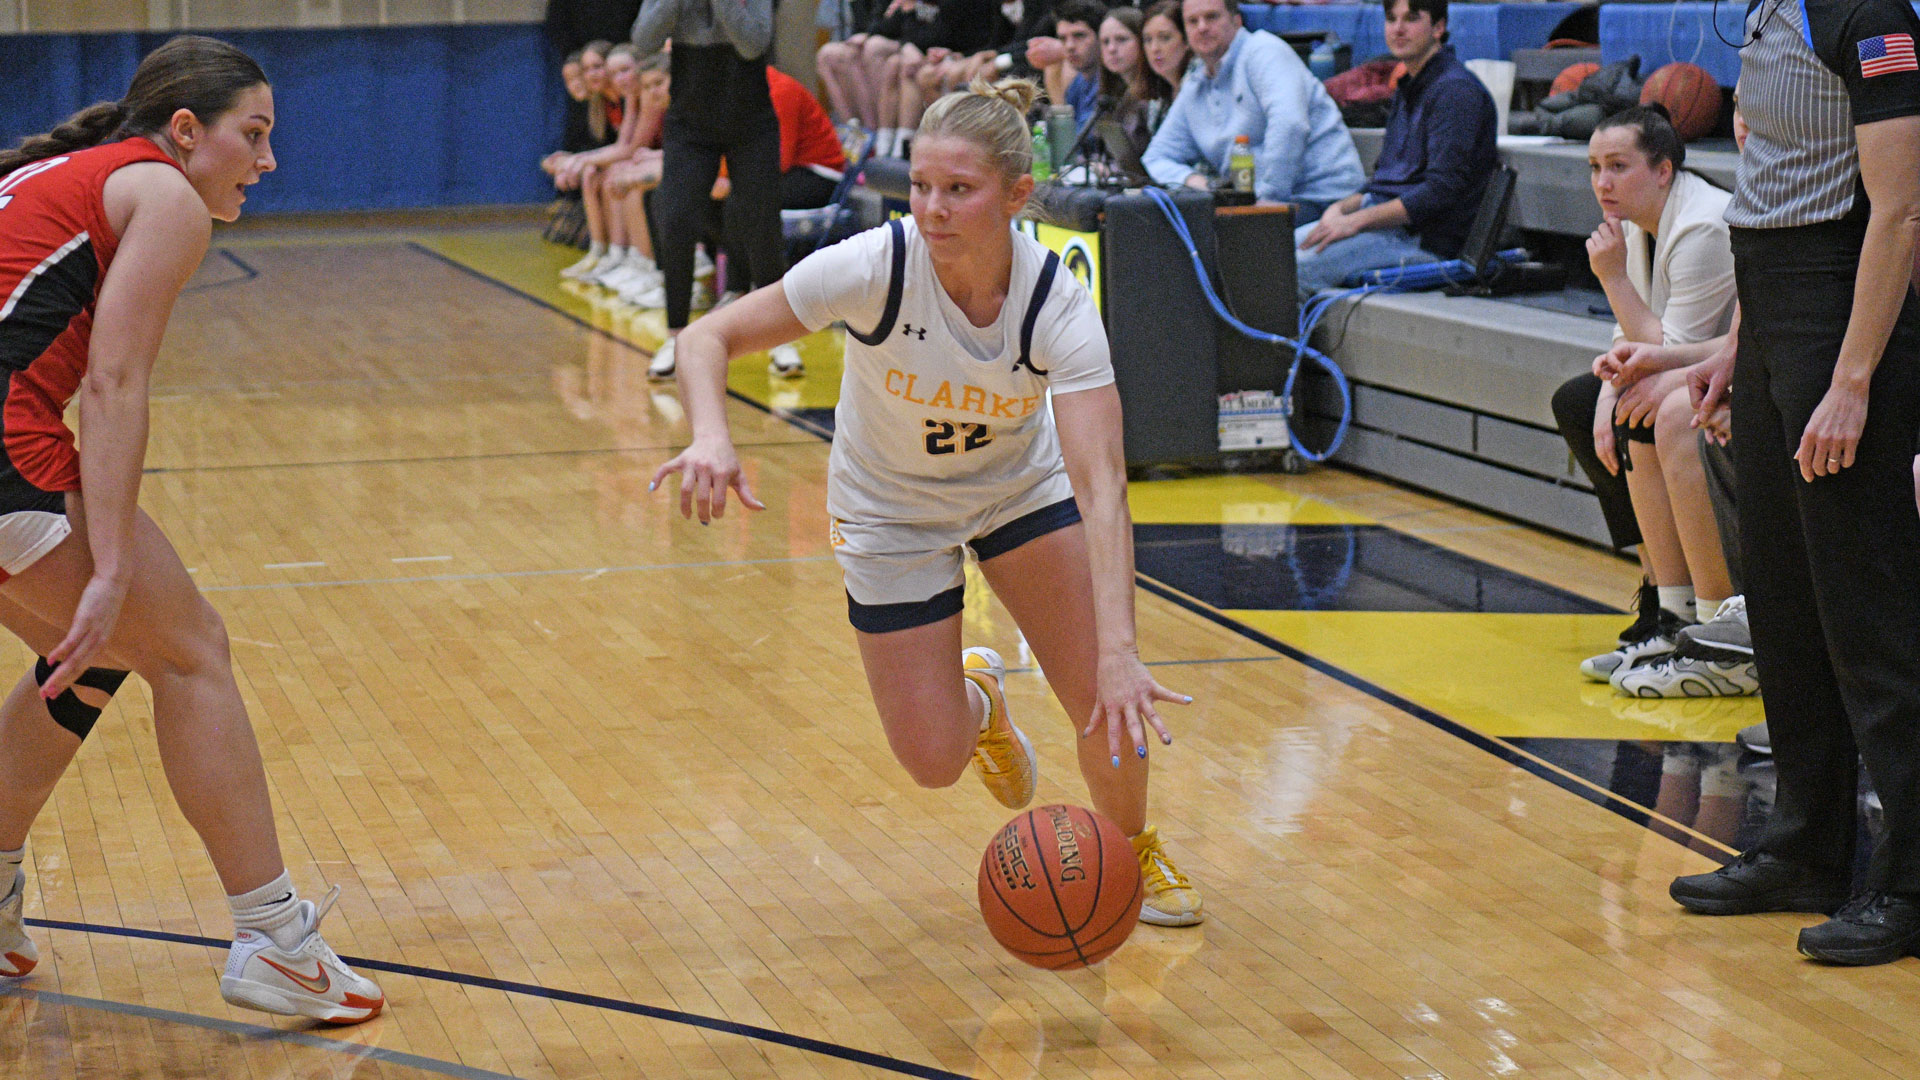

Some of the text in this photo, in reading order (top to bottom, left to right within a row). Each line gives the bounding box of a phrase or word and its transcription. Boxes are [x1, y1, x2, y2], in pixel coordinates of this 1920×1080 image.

[885, 368, 1039, 418] CLARKE
[921, 417, 996, 455] 22
[1004, 824, 1037, 891] EGACY
[1043, 805, 1086, 882] PALDING
